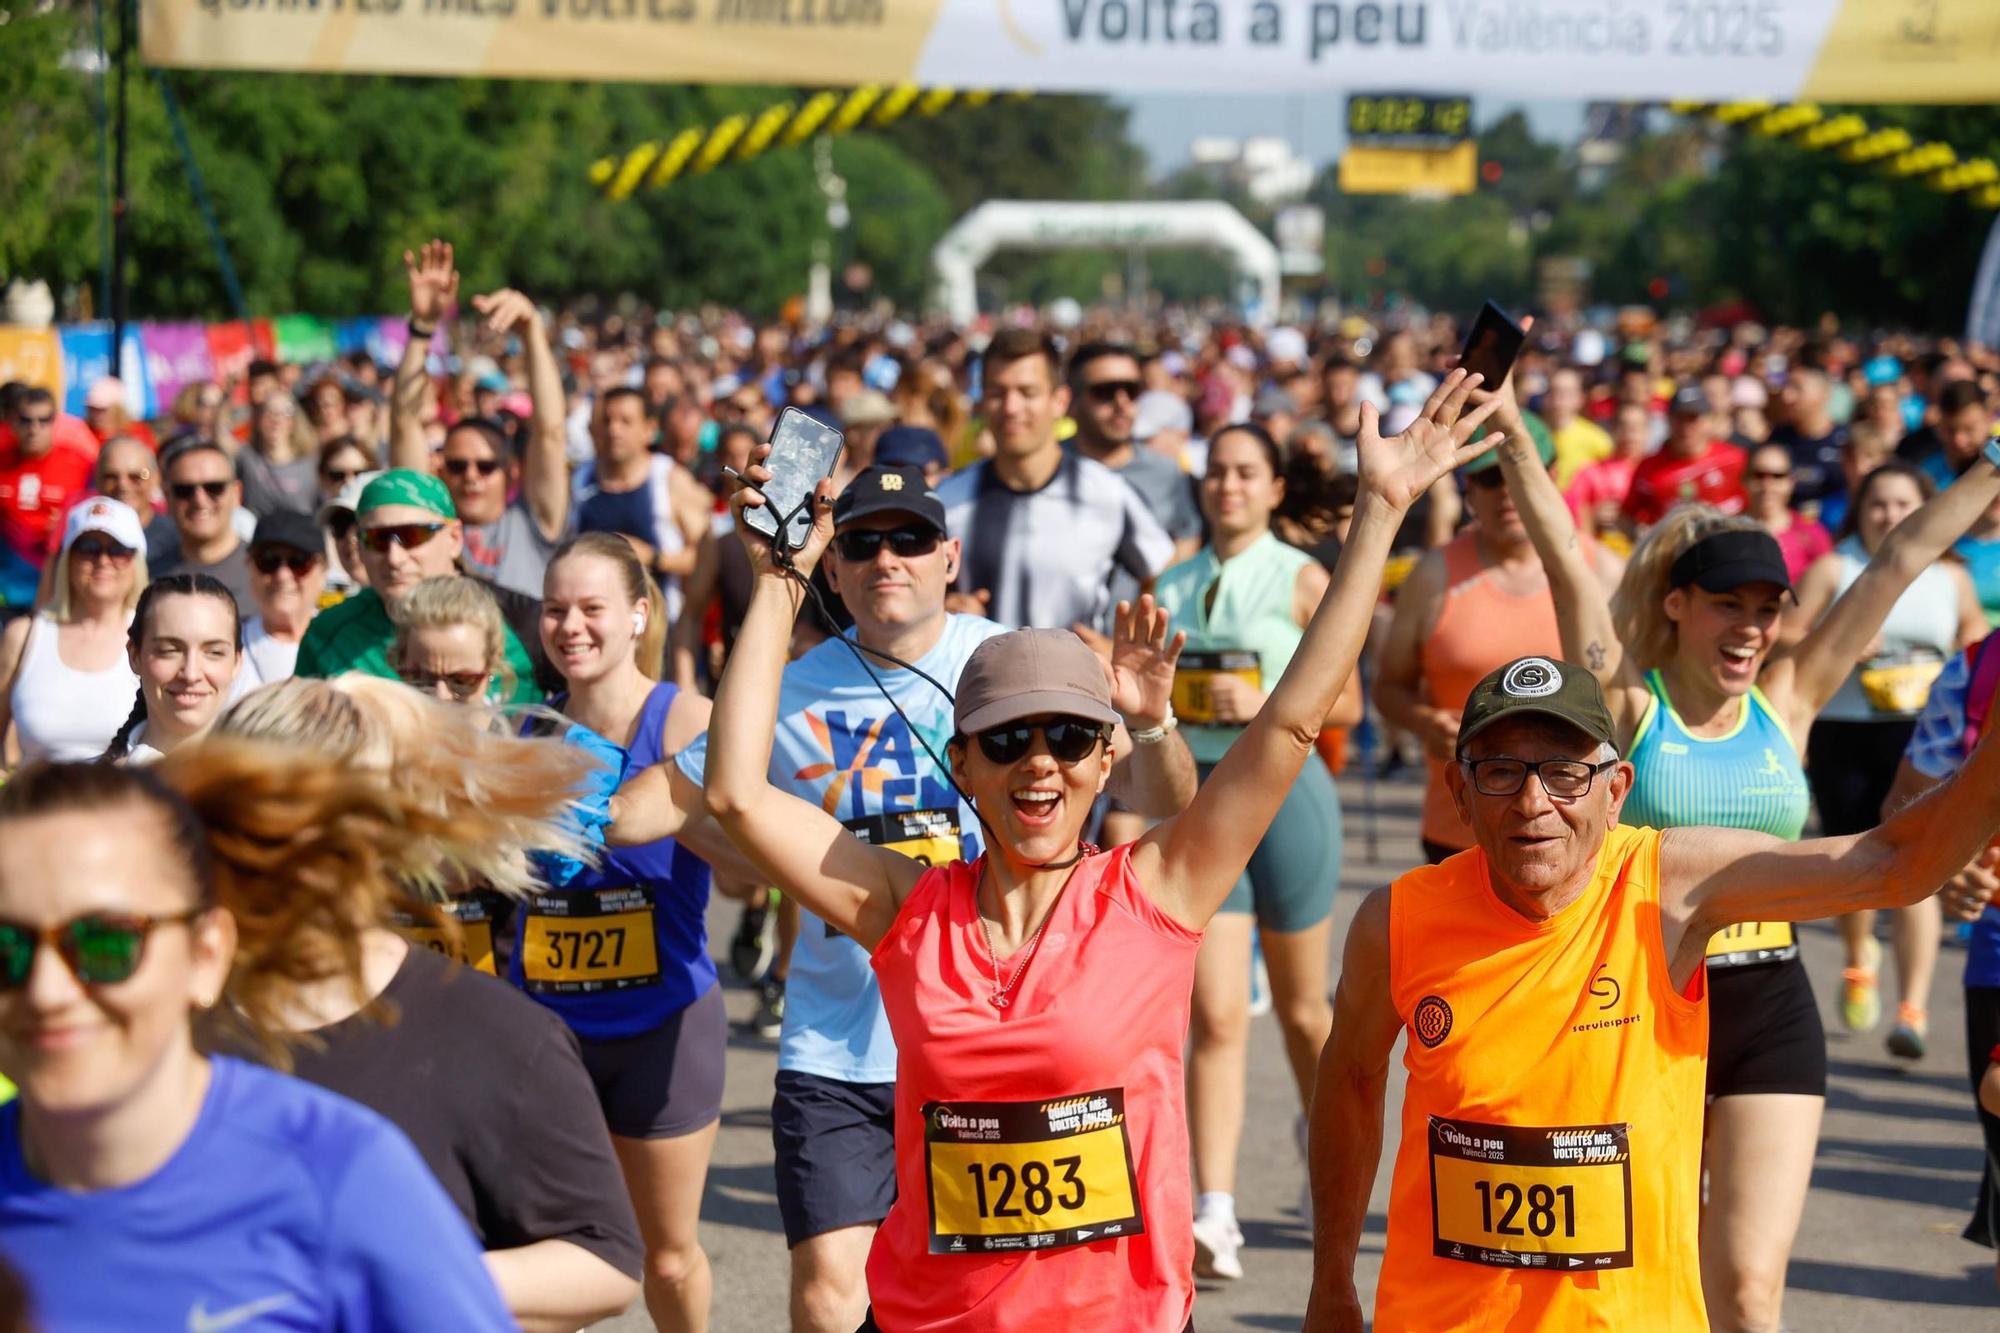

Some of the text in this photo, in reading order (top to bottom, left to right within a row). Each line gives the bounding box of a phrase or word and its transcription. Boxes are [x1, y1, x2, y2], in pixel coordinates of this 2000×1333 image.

[1063, 0, 1221, 44] Volta
[1250, 0, 1281, 44] a
[1310, 1, 1427, 62] peu
[1664, 0, 1786, 57] 2025
[545, 928, 626, 970] 3727
[940, 1115, 1000, 1132] Volta a peu
[1446, 1130, 1504, 1151] Volta a peu
[1552, 1131, 1613, 1148] QUANTES MÉS
[1488, 1150, 1505, 1160] 2025
[1552, 1145, 1618, 1159] VOLTES MILLOR
[967, 1155, 1087, 1219] 1283
[1474, 1180, 1576, 1238] 1281
